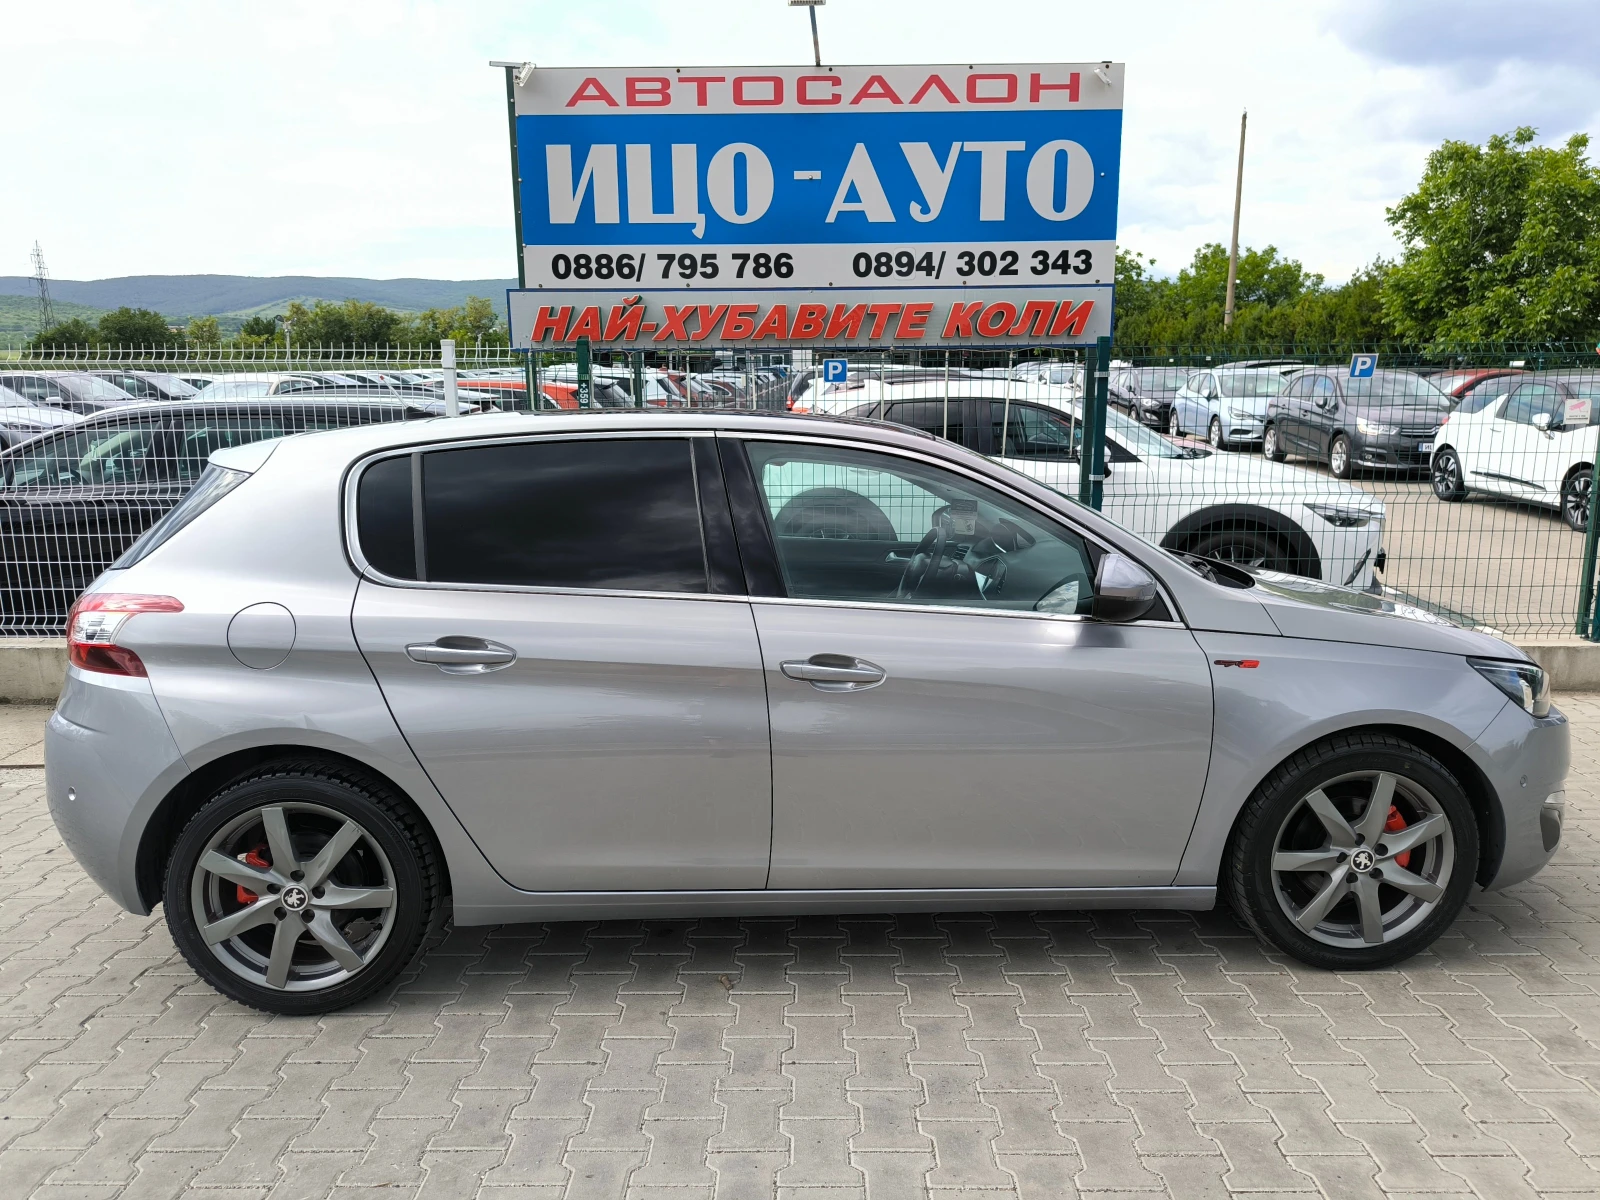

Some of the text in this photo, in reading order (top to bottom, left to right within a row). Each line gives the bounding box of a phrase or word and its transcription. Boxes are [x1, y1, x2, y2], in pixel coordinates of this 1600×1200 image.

[565, 72, 1081, 108] АВТОСАЛОН
[551, 250, 1093, 282] 0886/ 795 786 0894/ 302 343
[530, 295, 1095, 342] НАЙ-ХУБАВИТЕ КОЛИ
[828, 361, 843, 380] P
[1354, 357, 1371, 376] P
